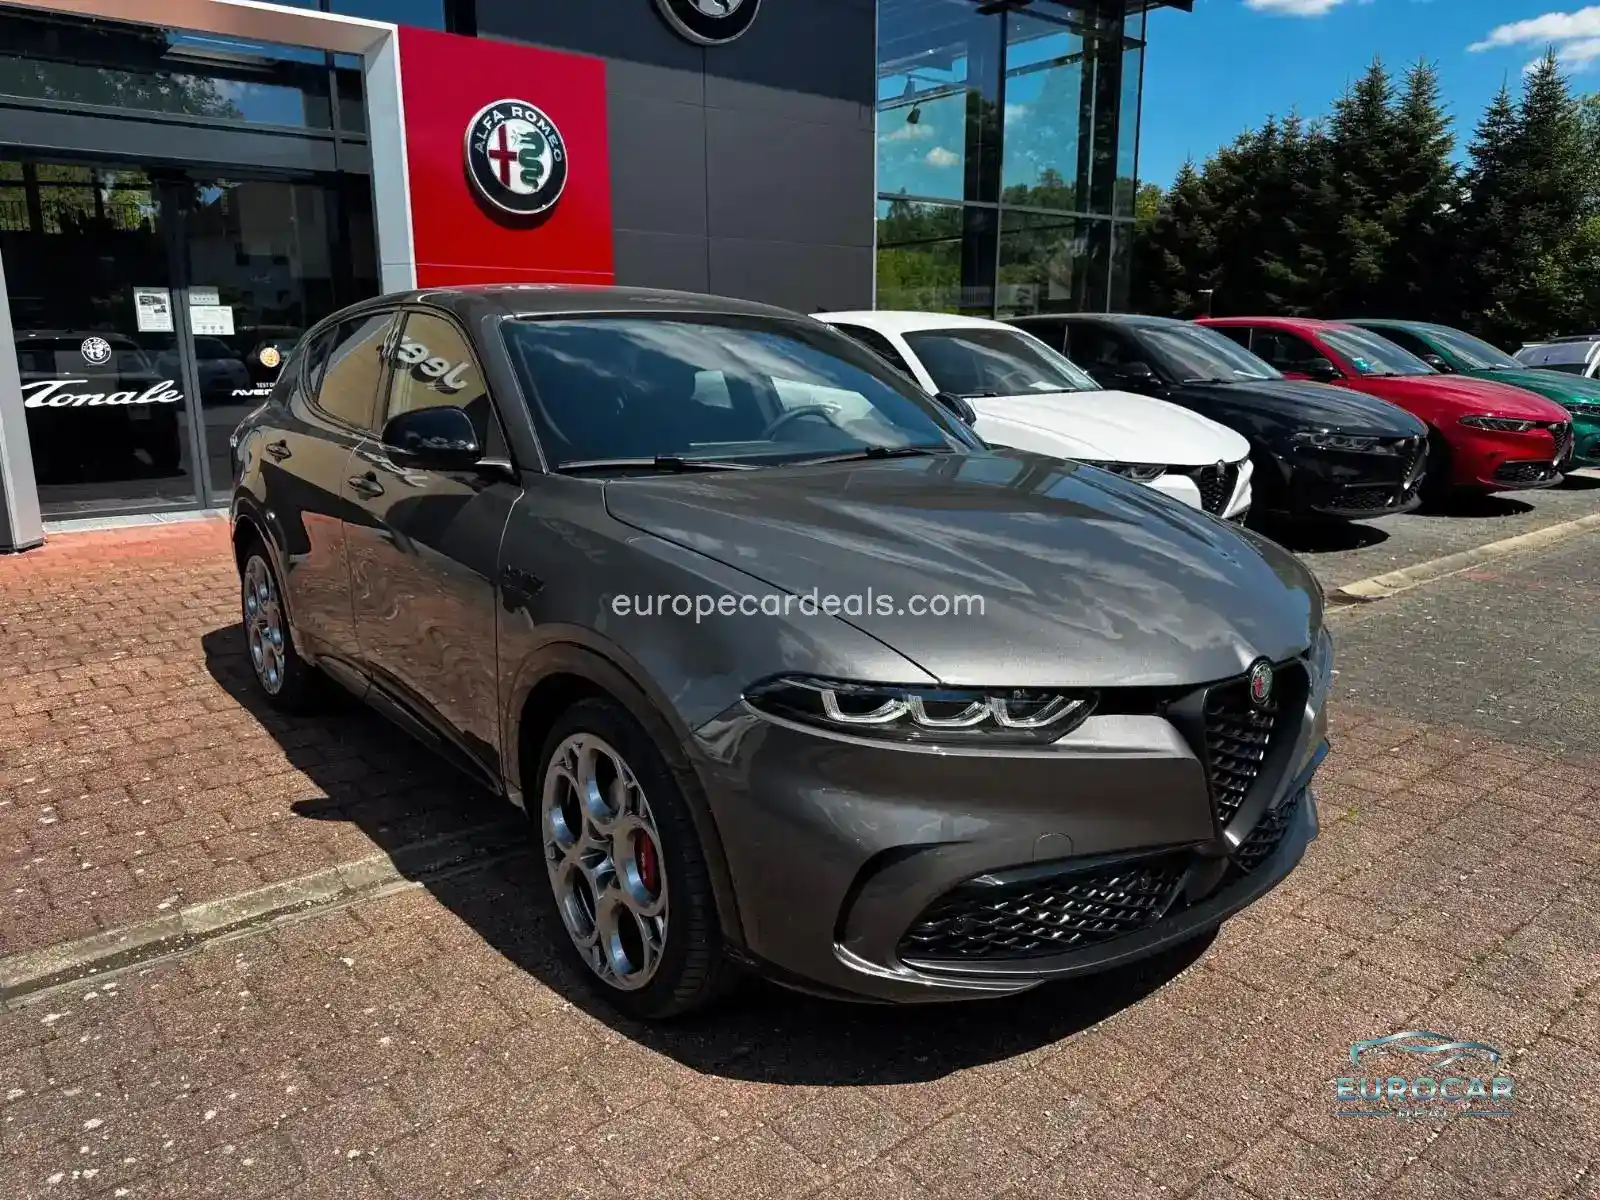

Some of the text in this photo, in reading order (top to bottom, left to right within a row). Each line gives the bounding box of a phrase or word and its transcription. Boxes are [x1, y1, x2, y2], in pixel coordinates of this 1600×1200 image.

[474, 106, 563, 162] ALFA ROMEO
[20, 379, 184, 408] Tonale
